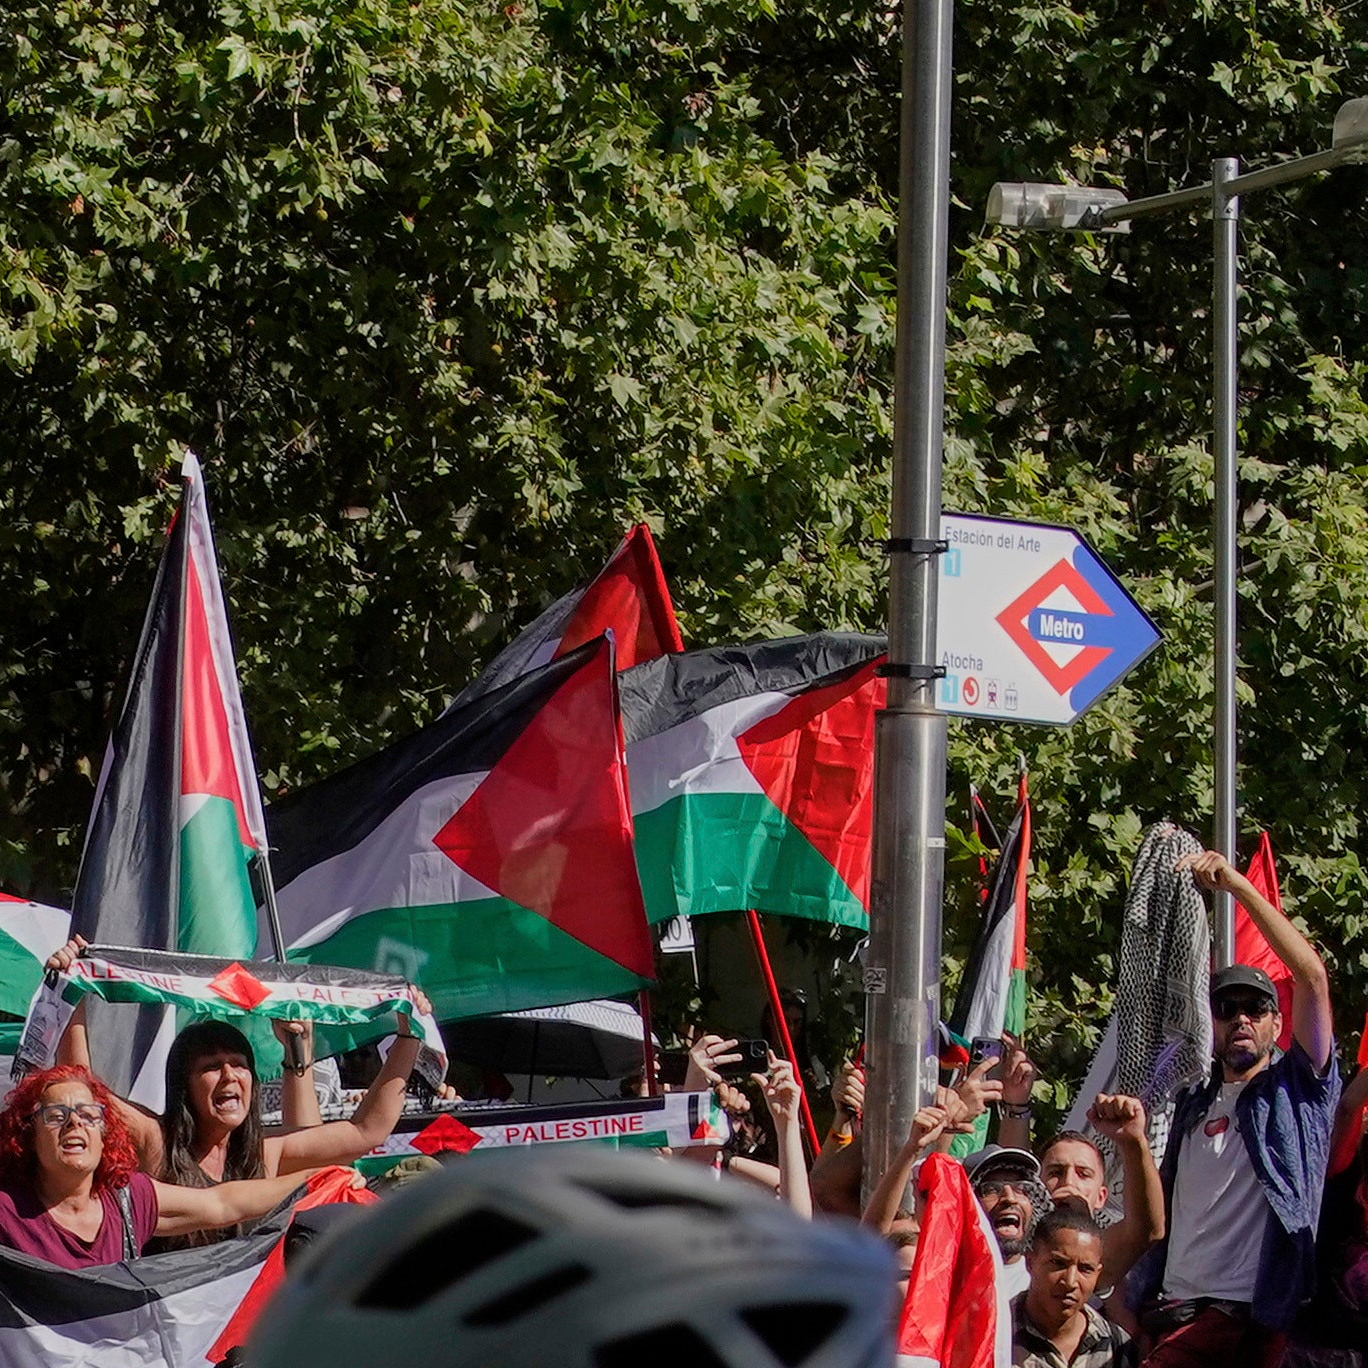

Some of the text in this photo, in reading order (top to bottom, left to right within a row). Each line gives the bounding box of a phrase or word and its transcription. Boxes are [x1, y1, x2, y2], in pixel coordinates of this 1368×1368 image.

[945, 525, 1041, 553] Estación del Arte
[1040, 613, 1084, 640] Metro
[942, 650, 984, 672] Atocha
[504, 1114, 644, 1144] PALESTINE
